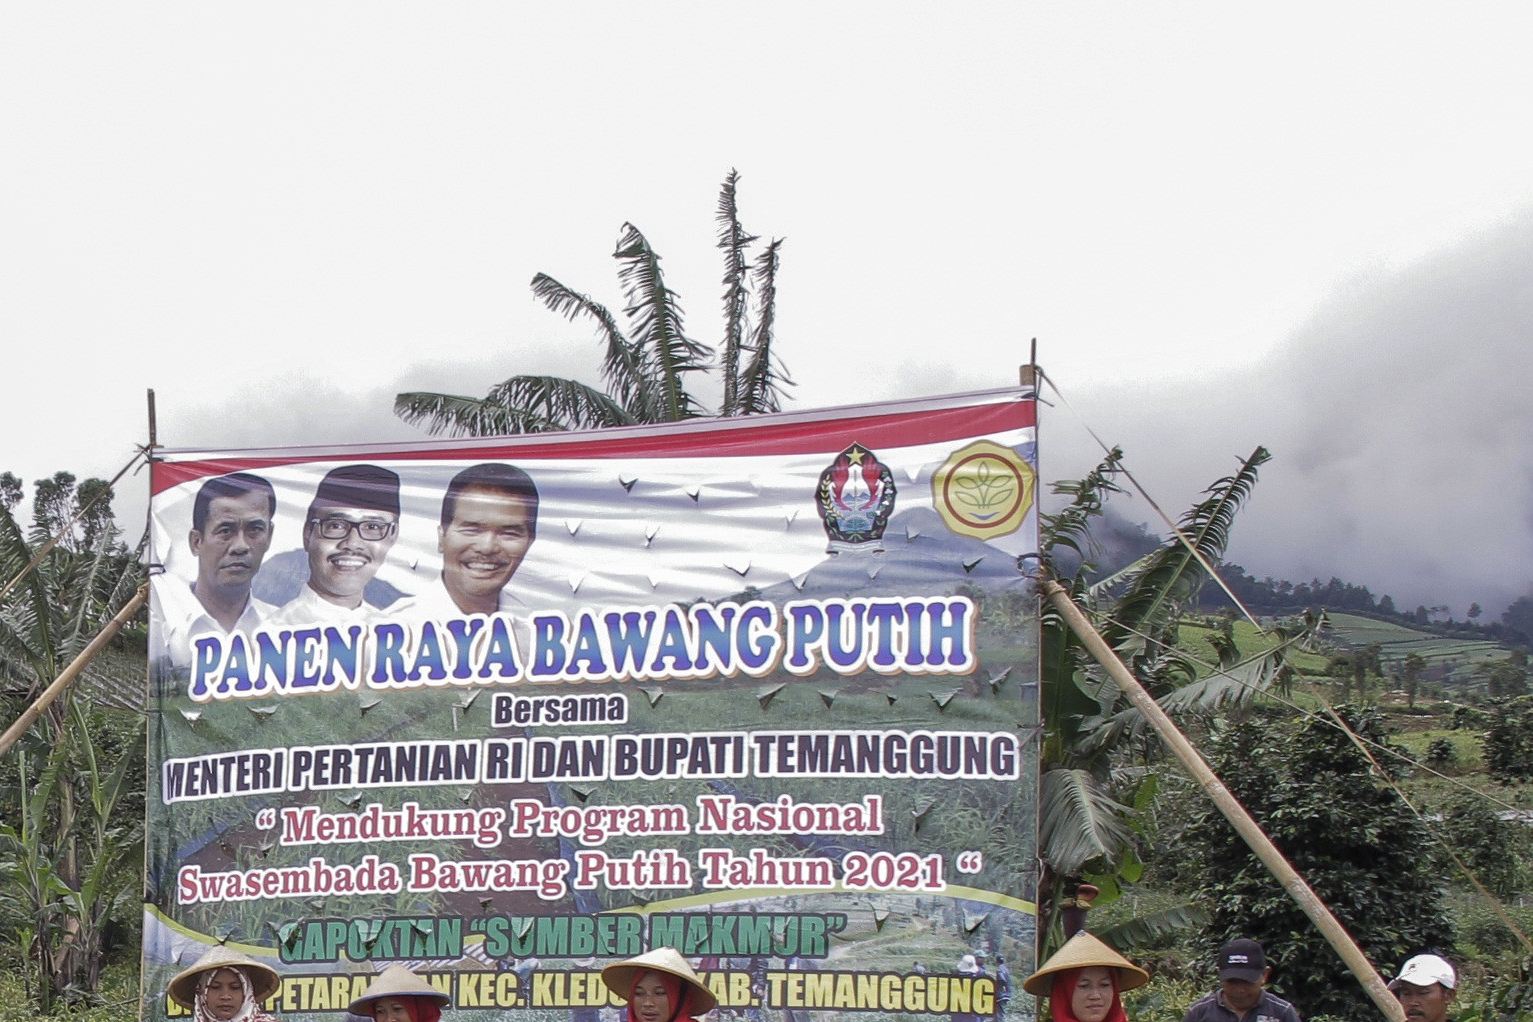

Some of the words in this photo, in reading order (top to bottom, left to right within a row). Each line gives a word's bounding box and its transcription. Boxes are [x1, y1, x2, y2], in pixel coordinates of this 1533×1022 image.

[193, 624, 362, 697] PANEN
[371, 617, 519, 683] RAYA
[531, 602, 776, 675] BAWANG
[788, 600, 967, 668] PUTIH
[494, 694, 624, 725] Bersama
[167, 752, 283, 798] MENTERI
[292, 743, 475, 787] PERTANIAN
[486, 742, 522, 779] RI
[532, 740, 604, 778] DAN
[614, 736, 743, 776] BUPATI
[754, 734, 1015, 776] TEMANGGUNG
[282, 806, 502, 845] Mendukung
[512, 801, 687, 840] Program
[698, 797, 883, 832] Nasional
[178, 858, 399, 900] Swasembada
[410, 856, 566, 896] Bawang
[577, 851, 689, 887] Putih
[702, 851, 831, 886] Tahun
[846, 854, 942, 888] 2021
[281, 917, 462, 961] GAPOKTAN
[458, 972, 524, 1007] KEC.
[767, 971, 995, 1015] TEMANGGUNG
